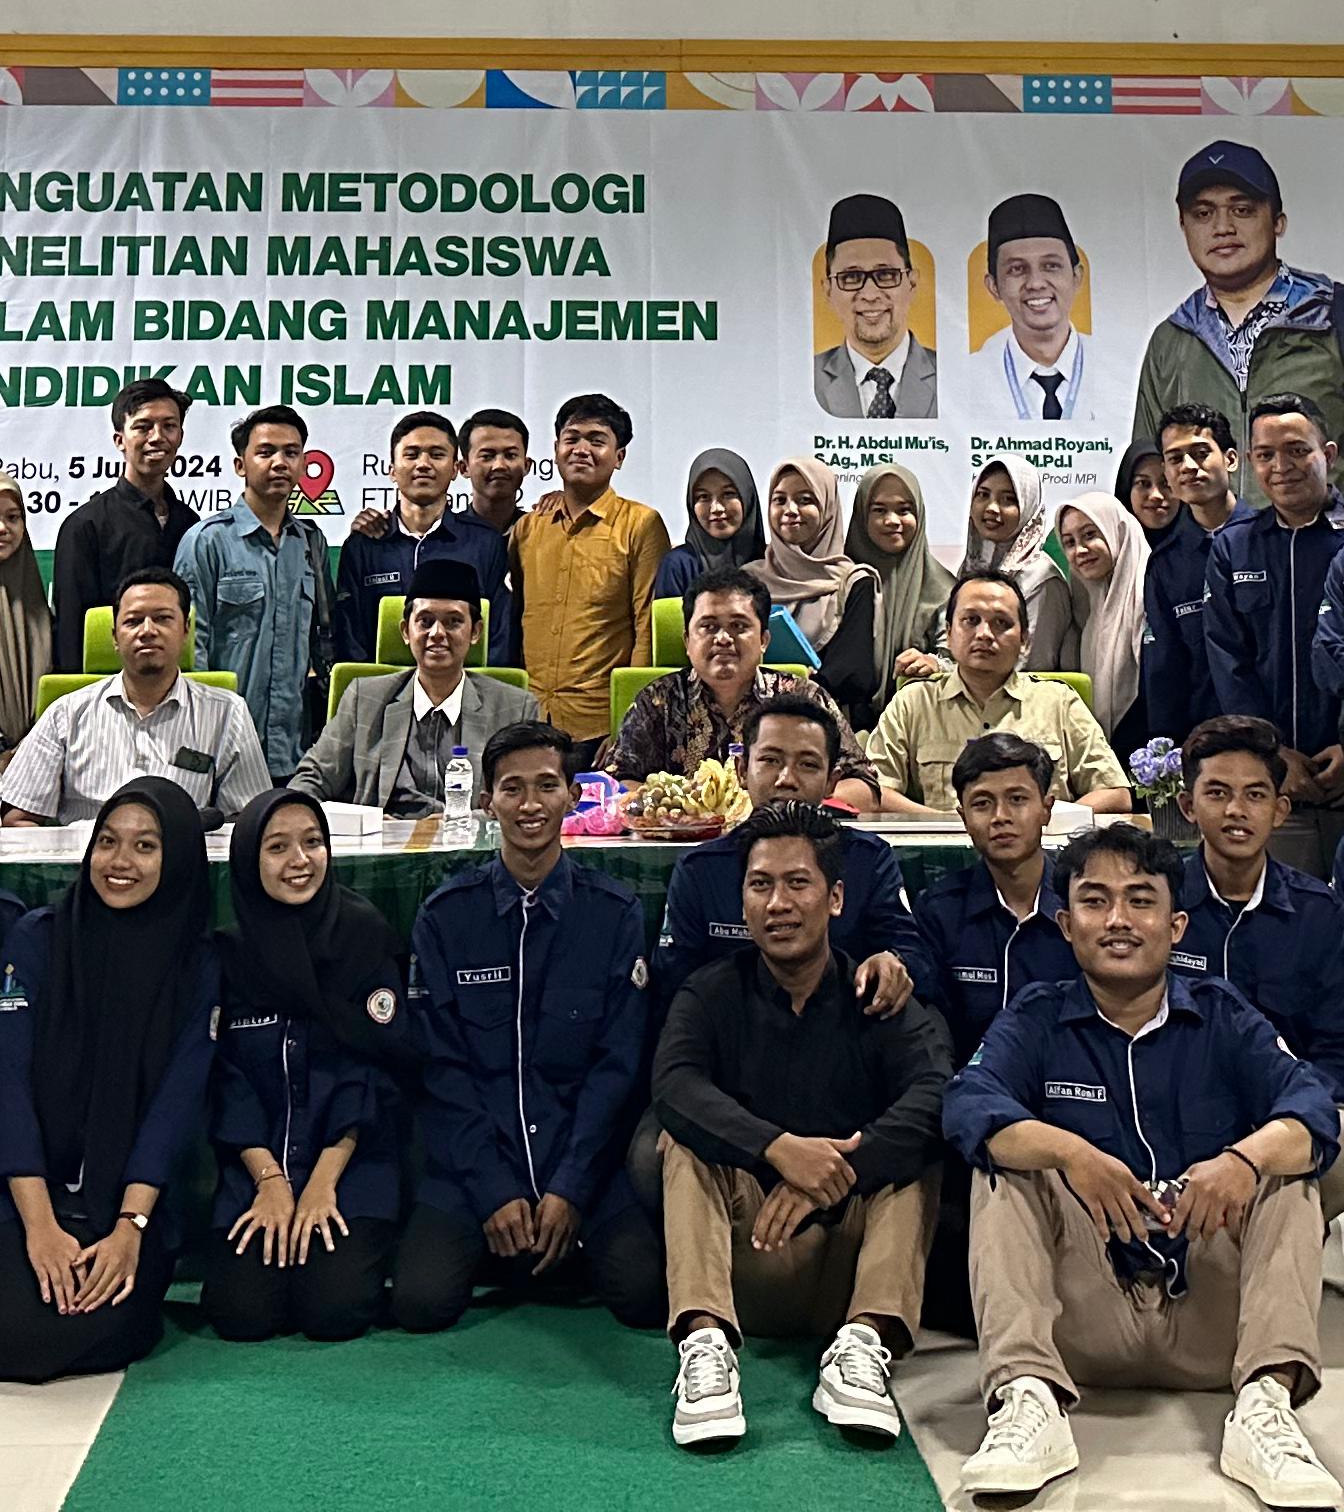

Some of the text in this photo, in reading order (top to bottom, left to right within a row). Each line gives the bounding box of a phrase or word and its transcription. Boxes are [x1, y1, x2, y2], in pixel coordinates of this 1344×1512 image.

[281, 172, 645, 214] METODOLOGI
[267, 236, 612, 277] MAHASISWA
[133, 300, 346, 341] BIDANG
[366, 299, 718, 341] MANAJEMEN
[280, 364, 452, 407] ISLAM
[814, 436, 836, 449] Dr.
[839, 436, 854, 449] H.
[856, 436, 903, 450] Abdul
[971, 437, 1113, 454] Dr. Ahmad Royani,
[68, 456, 85, 478] 5
[163, 455, 222, 478] 024
[1042, 473, 1097, 485] Prodi MPI
[180, 489, 232, 511] WIB
